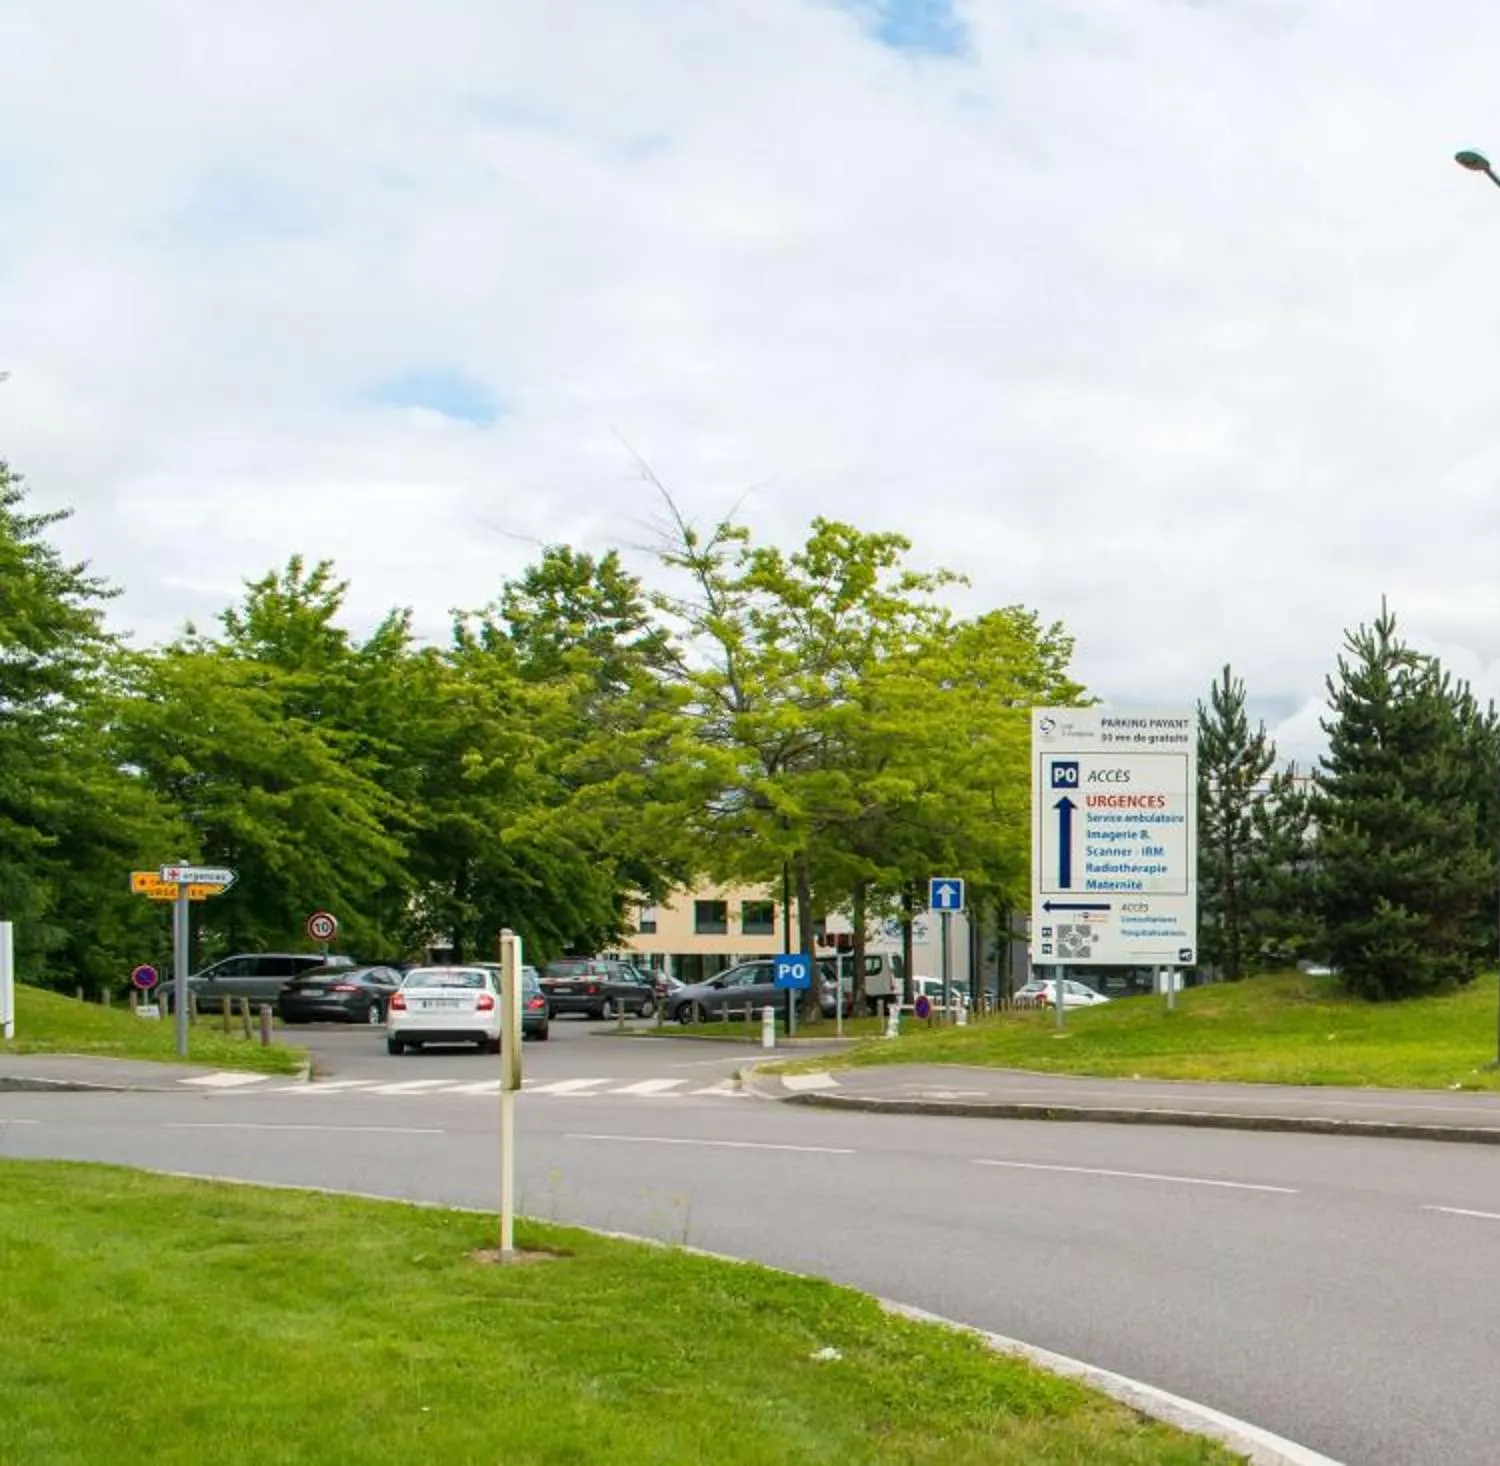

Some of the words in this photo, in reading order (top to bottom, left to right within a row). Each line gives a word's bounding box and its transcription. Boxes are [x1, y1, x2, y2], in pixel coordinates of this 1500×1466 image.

[1101, 719, 1147, 729] PARKING
[1149, 719, 1189, 729] PAYANT
[1087, 767, 1131, 783] ACCÈS
[1086, 795, 1165, 808] URGENCES
[1087, 813, 1122, 823] Service
[1124, 813, 1185, 823] ambulatoire
[1087, 830, 1138, 842] Imagerie
[1087, 846, 1133, 857] Scanner
[1141, 846, 1164, 857] IRM
[1086, 880, 1143, 890] Maternité
[315, 921, 329, 933] 10
